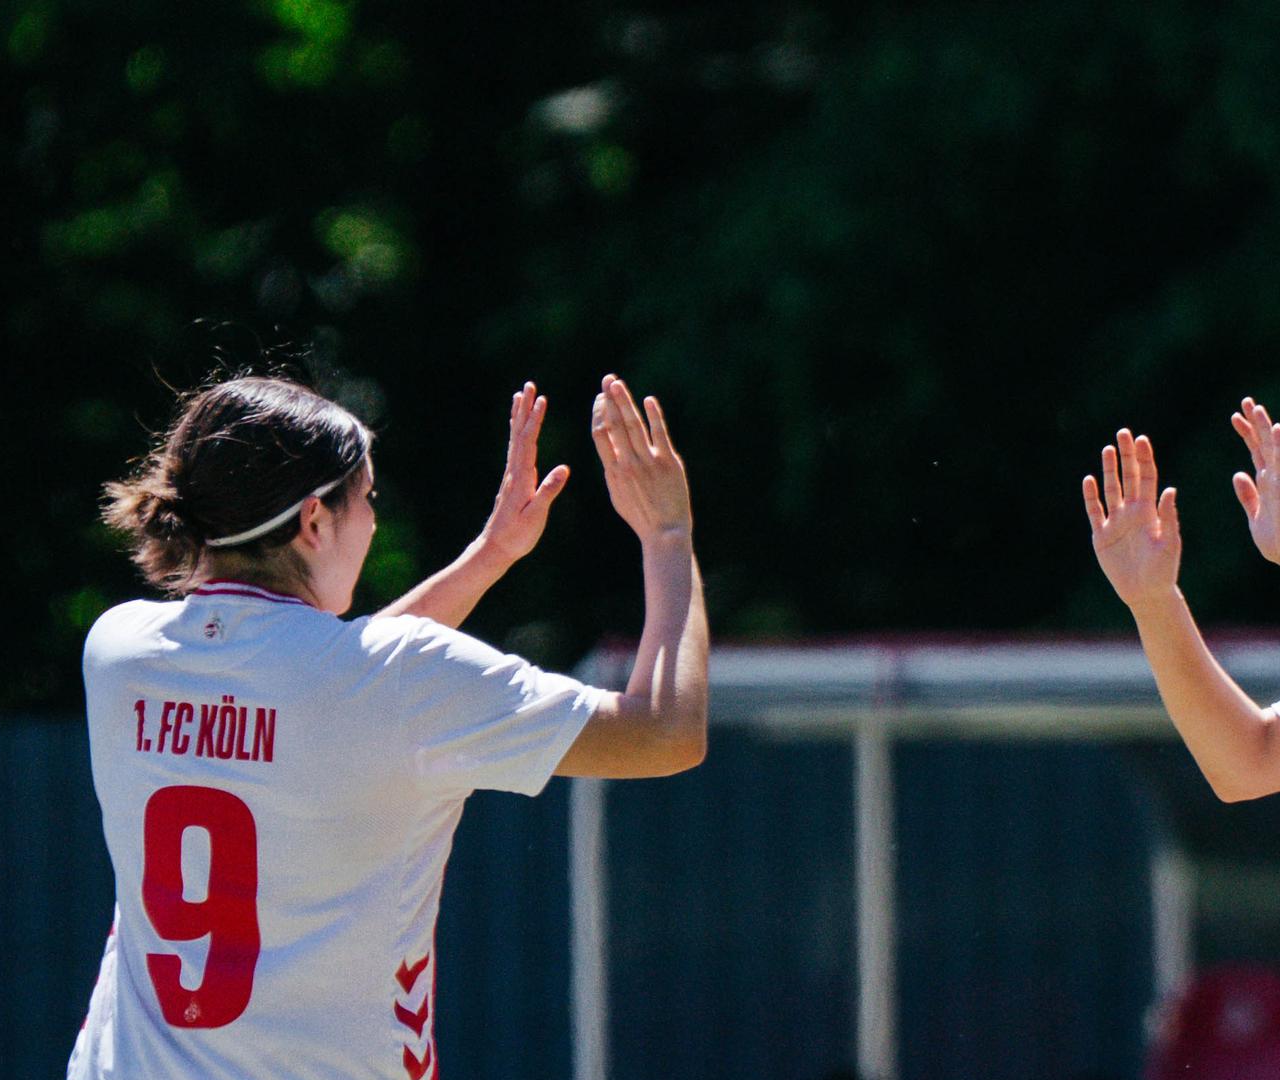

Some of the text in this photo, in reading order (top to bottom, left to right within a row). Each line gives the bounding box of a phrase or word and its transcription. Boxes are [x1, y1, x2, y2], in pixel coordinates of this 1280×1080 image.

[134, 695, 277, 762] 1. FC KÖLN
[141, 785, 261, 1029] 9
